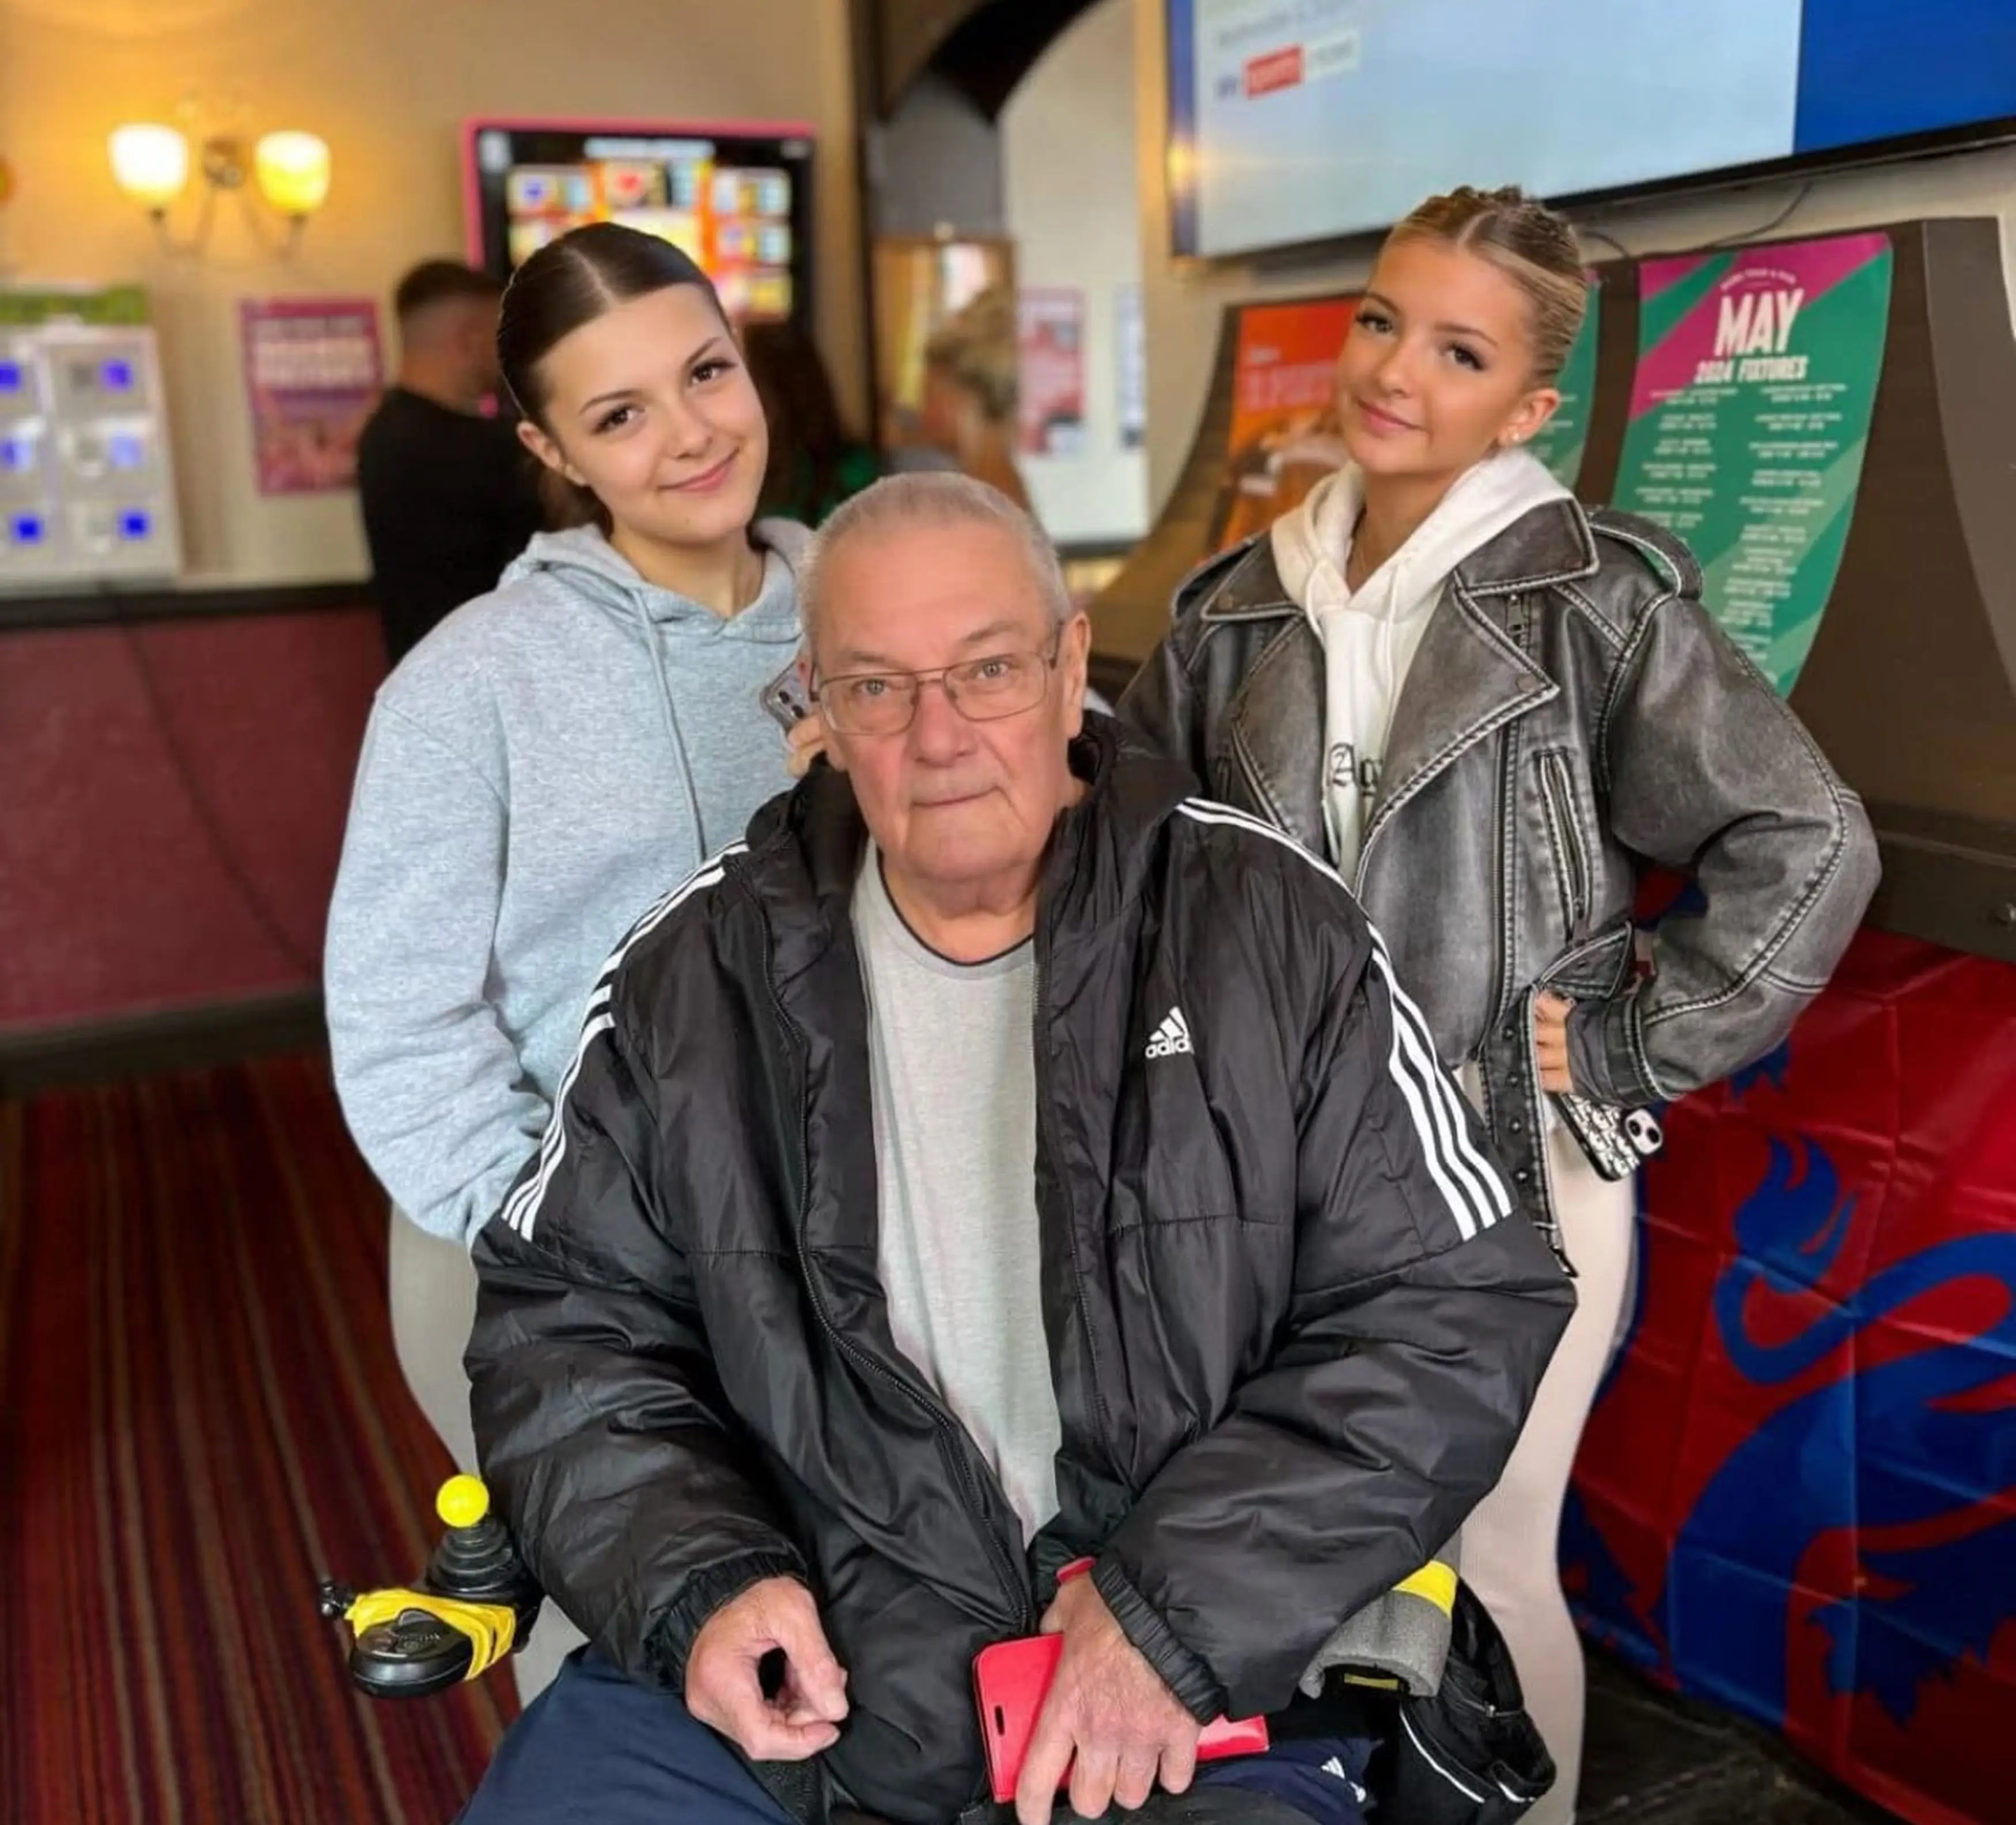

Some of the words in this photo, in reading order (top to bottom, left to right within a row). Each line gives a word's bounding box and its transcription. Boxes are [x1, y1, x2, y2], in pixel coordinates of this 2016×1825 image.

[1714, 289, 1803, 355] MAY
[1738, 356, 1809, 382] FIXTURES
[1145, 1034, 1195, 1058] adid
